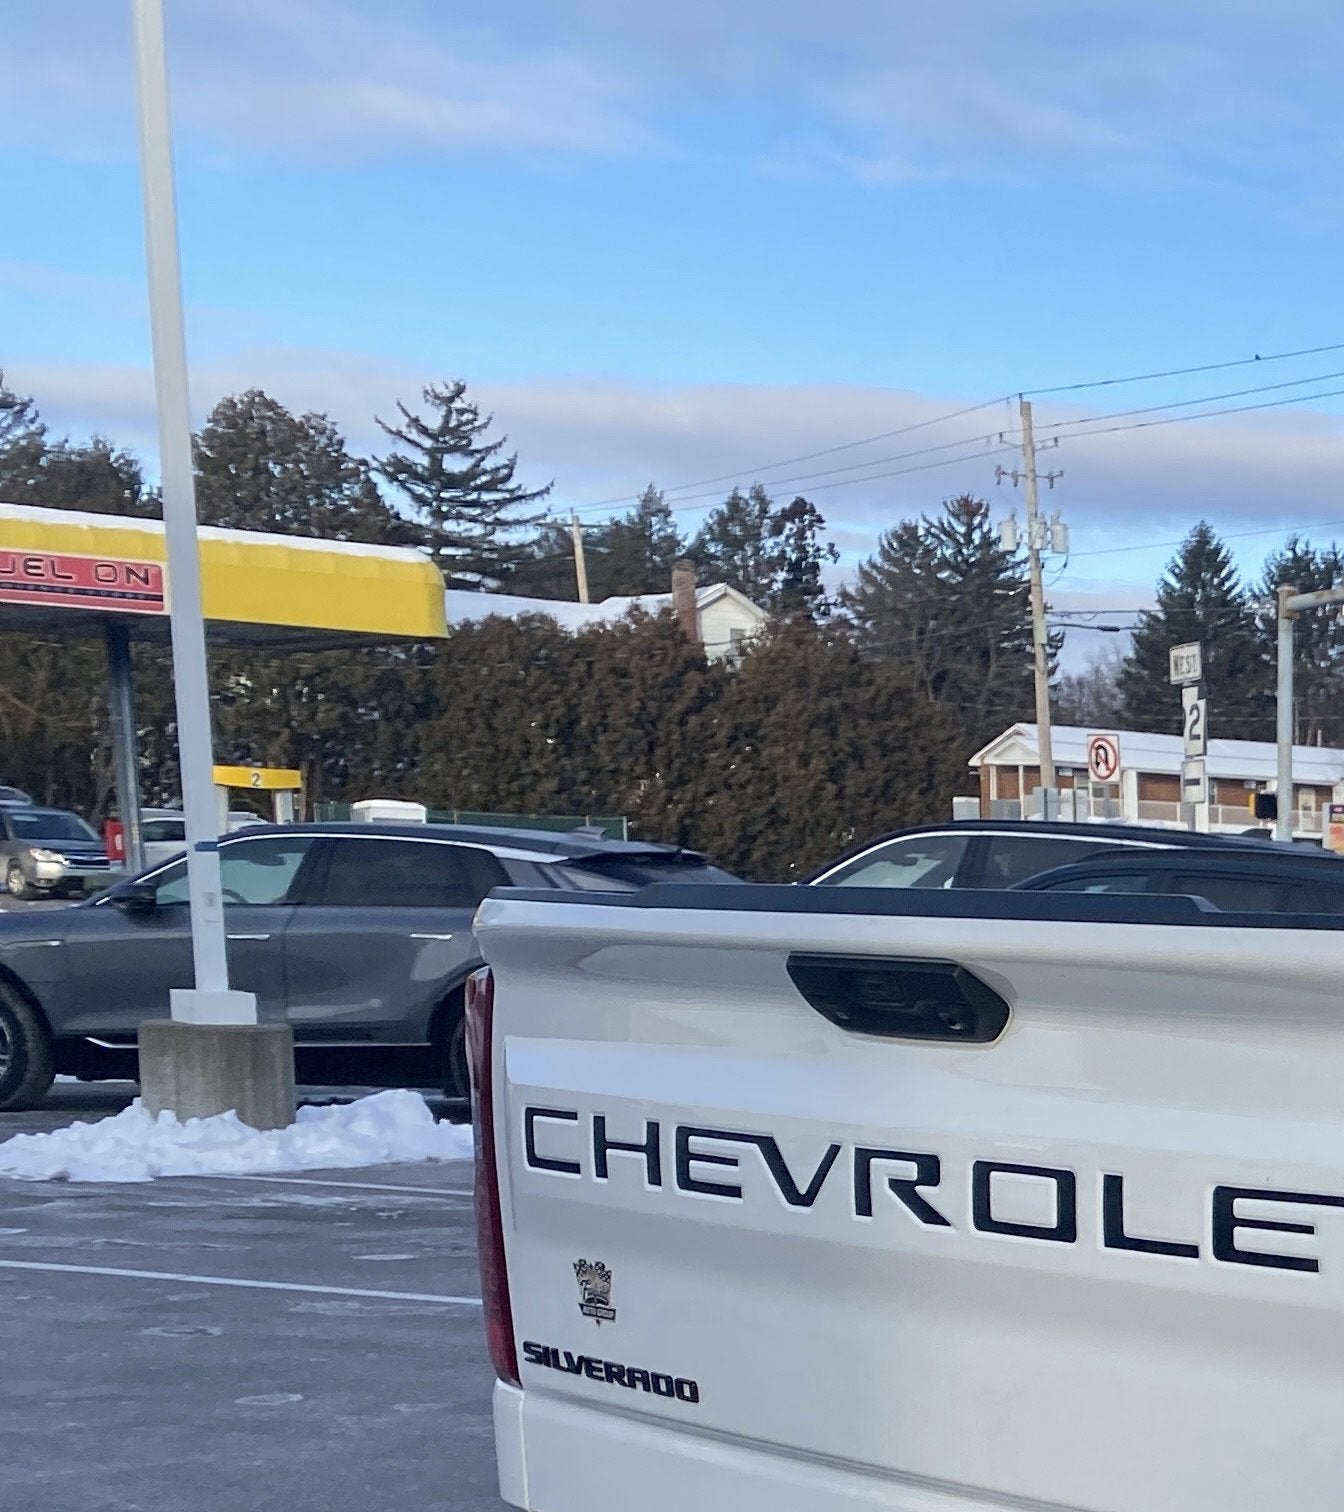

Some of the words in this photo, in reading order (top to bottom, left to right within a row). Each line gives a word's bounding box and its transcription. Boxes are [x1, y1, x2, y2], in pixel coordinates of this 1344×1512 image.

[94, 563, 151, 586] ON
[1172, 653, 1199, 678] WEST
[251, 772, 261, 787] 2
[522, 1340, 700, 1404] SILVERADO
